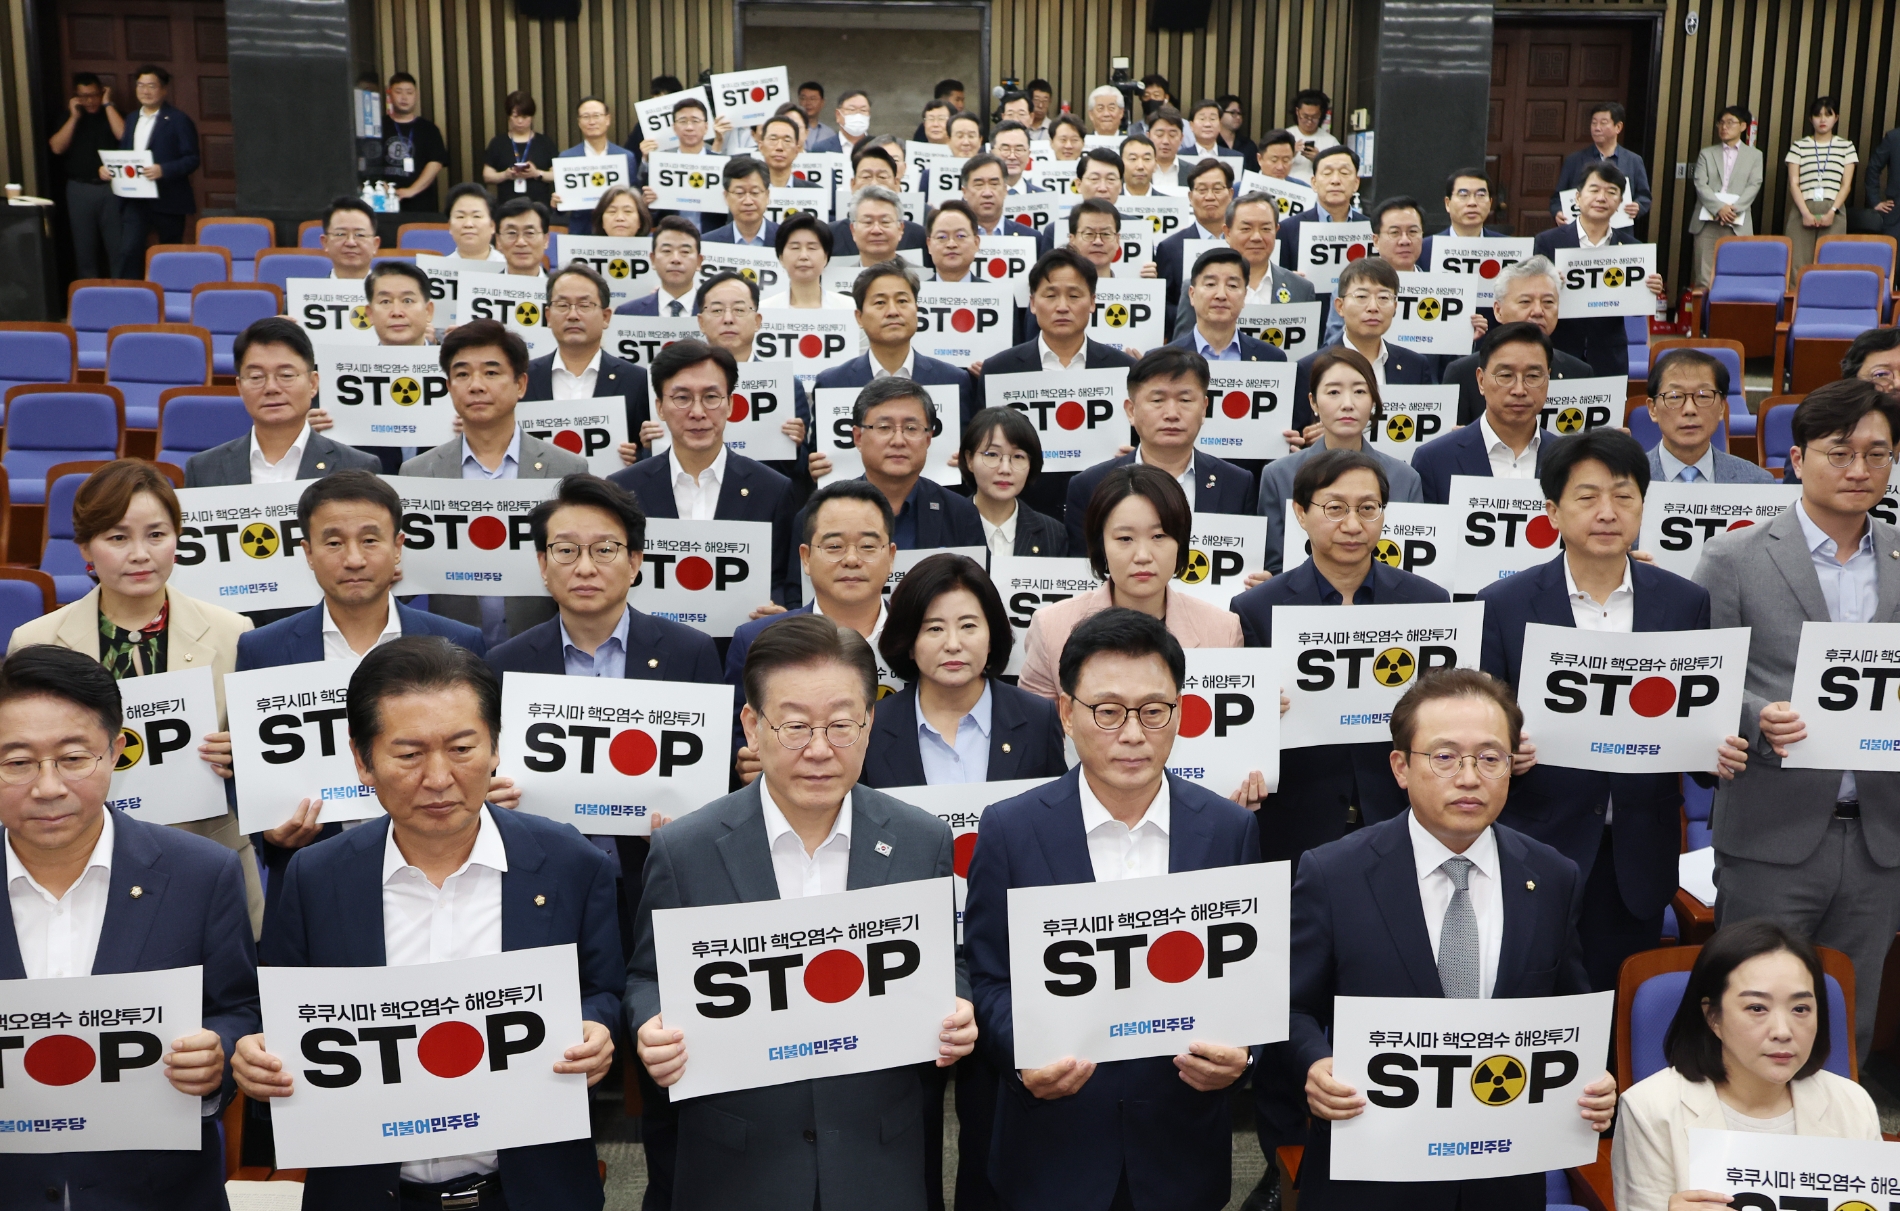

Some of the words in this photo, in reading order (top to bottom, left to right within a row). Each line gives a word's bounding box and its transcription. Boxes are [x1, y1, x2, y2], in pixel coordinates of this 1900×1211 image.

[723, 85, 779, 106] STOP
[565, 171, 619, 188] STOP
[659, 170, 720, 189] STOP
[973, 258, 1026, 278] TOP
[1568, 259, 1592, 267] 후쿠시마
[1593, 258, 1618, 266] 핵오염수
[1619, 257, 1645, 265] 해양투기
[1566, 267, 1645, 289] STOP
[303, 294, 334, 302] 후쿠시마
[335, 294, 365, 302] 핵오염수
[472, 287, 501, 296] 후쿠시마
[503, 289, 532, 299] 핵오염수
[1122, 293, 1151, 302] 해양투기
[1407, 286, 1435, 294] 핵오염수
[1436, 287, 1464, 296] 해양투기
[940, 297, 968, 306] 핵오염수
[969, 297, 999, 306] 해양투기
[1398, 297, 1463, 321] TOP
[303, 303, 373, 330] STO
[471, 298, 547, 327] STO
[1091, 303, 1151, 328] TOP
[1249, 317, 1277, 325] 핵오염수
[1279, 316, 1307, 325] 해양투기
[617, 330, 646, 338] 후쿠시마
[648, 330, 677, 339] 핵오염수
[787, 323, 815, 331] 핵오염수
[817, 323, 846, 332] 해양투기
[756, 332, 845, 359] STOP
[335, 362, 372, 373] 후쿠시마
[373, 363, 409, 374] 핵오염수
[741, 380, 777, 390] 해양투기
[1209, 378, 1243, 388] 핵오염수
[1245, 378, 1280, 388] 해양투기
[1003, 389, 1038, 400] 후쿠시마
[1040, 388, 1076, 398] 핵오염수
[1078, 386, 1113, 397] 해양투기
[1546, 396, 1577, 406] 핵오염수
[1580, 394, 1611, 405] 해양투기
[1206, 390, 1278, 419] TOP
[1382, 402, 1406, 412] 오염수
[1408, 402, 1442, 412] 해양투기
[536, 417, 571, 429] 핵오염수
[573, 415, 609, 427] 해양투기
[1006, 399, 1113, 430] TOP
[1540, 406, 1611, 434] TOP
[371, 425, 416, 433] 더불어민주당
[1369, 414, 1441, 442] TOP
[1201, 437, 1243, 446] 더불어민주당
[1042, 449, 1081, 459] 불어민주당
[448, 500, 494, 512] 핵오염수
[1469, 497, 1510, 510] 후쿠시마
[1664, 503, 1708, 516] 후쿠시마
[1710, 504, 1753, 516] 핵오염수
[180, 510, 213, 524] 쿠시마
[216, 506, 262, 520] 핵오염수
[1393, 524, 1436, 537] 해양투기
[1464, 511, 1566, 550] STO
[657, 539, 702, 553] 핵오염수
[704, 541, 750, 554] 해양투기
[1202, 535, 1244, 547] 해양투기
[445, 571, 502, 582] 더불어민주당
[631, 554, 749, 591] TOP
[219, 581, 278, 596] 더불어민주당
[1010, 578, 1054, 590] 후쿠시마
[1056, 579, 1098, 591] 핵오염수
[1298, 631, 1350, 645] 후쿠시마
[1353, 630, 1403, 644] 핵오염수
[1406, 628, 1457, 642] 해양투기
[1549, 652, 1607, 670] 후쿠시마
[1611, 657, 1666, 672] 핵오염수
[1670, 656, 1723, 671] 해양투기
[1825, 649, 1878, 663] 후쿠시마
[1296, 645, 1458, 692] STOP
[1202, 675, 1255, 689] 해양투기
[256, 691, 317, 713] 후쿠시마
[1544, 669, 1720, 718] STOP
[126, 698, 186, 719] 해양투기
[528, 703, 585, 721] 후쿠시마
[588, 706, 644, 724] 핵오염수
[648, 709, 705, 727] 해양투기
[1340, 712, 1393, 726] 더불어민주
[523, 722, 704, 777] STOP
[1591, 742, 1661, 756] 더불어민주당
[575, 804, 647, 817] 더불어민주당
[1042, 915, 1114, 937] 후쿠시마
[1117, 906, 1186, 933] 핵오염수
[1190, 897, 1258, 922] 해양투기
[691, 935, 768, 960] 후쿠시마
[770, 924, 844, 952] 핵오염수
[847, 914, 919, 942] 해양투기
[1043, 921, 1258, 998] STOP
[693, 939, 921, 1019] STOP
[297, 1001, 377, 1024] 후쿠시마
[380, 995, 459, 1020] 핵오염수
[464, 984, 543, 1012] 해양투기
[79, 1006, 163, 1027] 해양투기
[1109, 1016, 1195, 1038] 더불어민주당
[1368, 1029, 1439, 1049] 후쿠시마
[1442, 1029, 1510, 1049] 핵오염수
[1514, 1027, 1579, 1047] 해양투기
[300, 1010, 546, 1089] STOP
[768, 1035, 859, 1061] 더불어민주당
[1365, 1050, 1579, 1110] STOP
[0, 1117, 86, 1133] 불어민주당
[382, 1113, 481, 1138] 더불어민주당
[1428, 1139, 1512, 1158] 더불어민주당
[1726, 1167, 1796, 1190] 후쿠시마
[1800, 1171, 1866, 1193] 핵오염수
